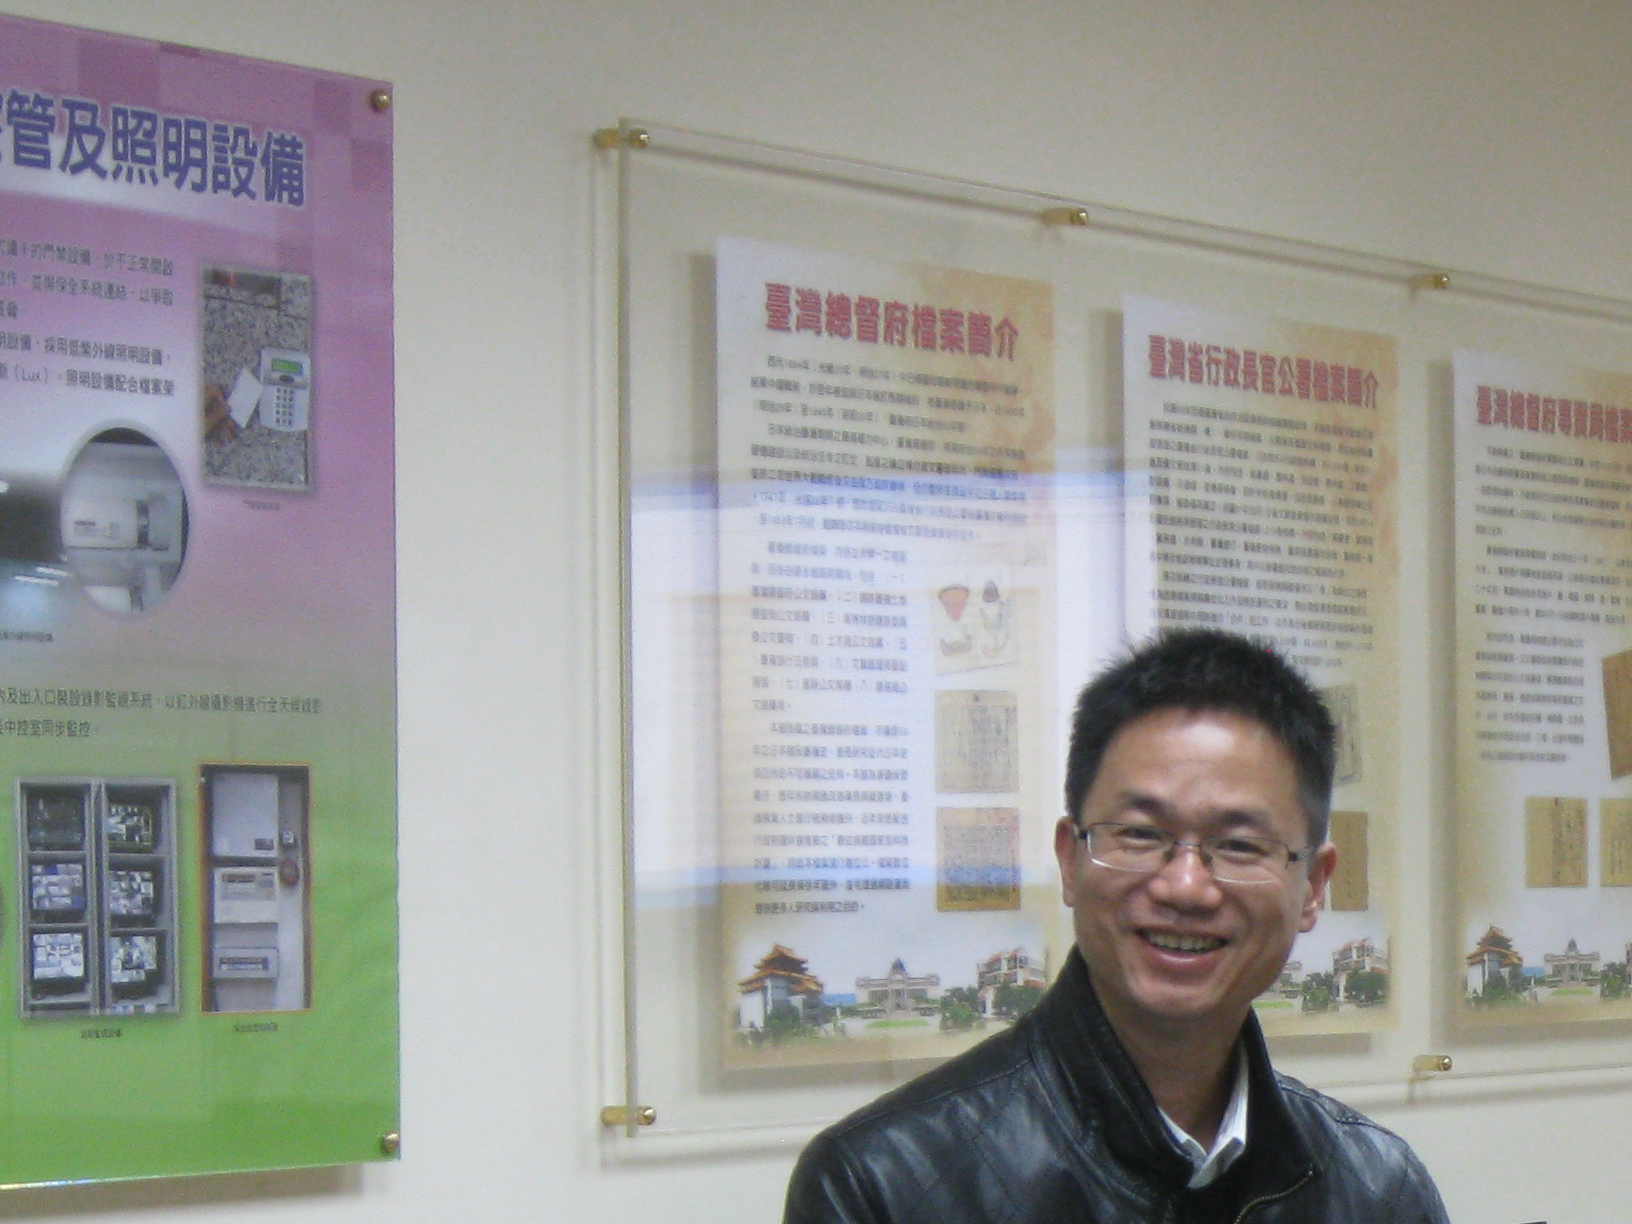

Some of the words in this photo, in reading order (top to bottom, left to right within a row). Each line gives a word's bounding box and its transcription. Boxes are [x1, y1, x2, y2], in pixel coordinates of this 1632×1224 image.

[0, 88, 305, 207] 管及照明設備
[765, 282, 1019, 362] 臺灣總督府檔案簡介
